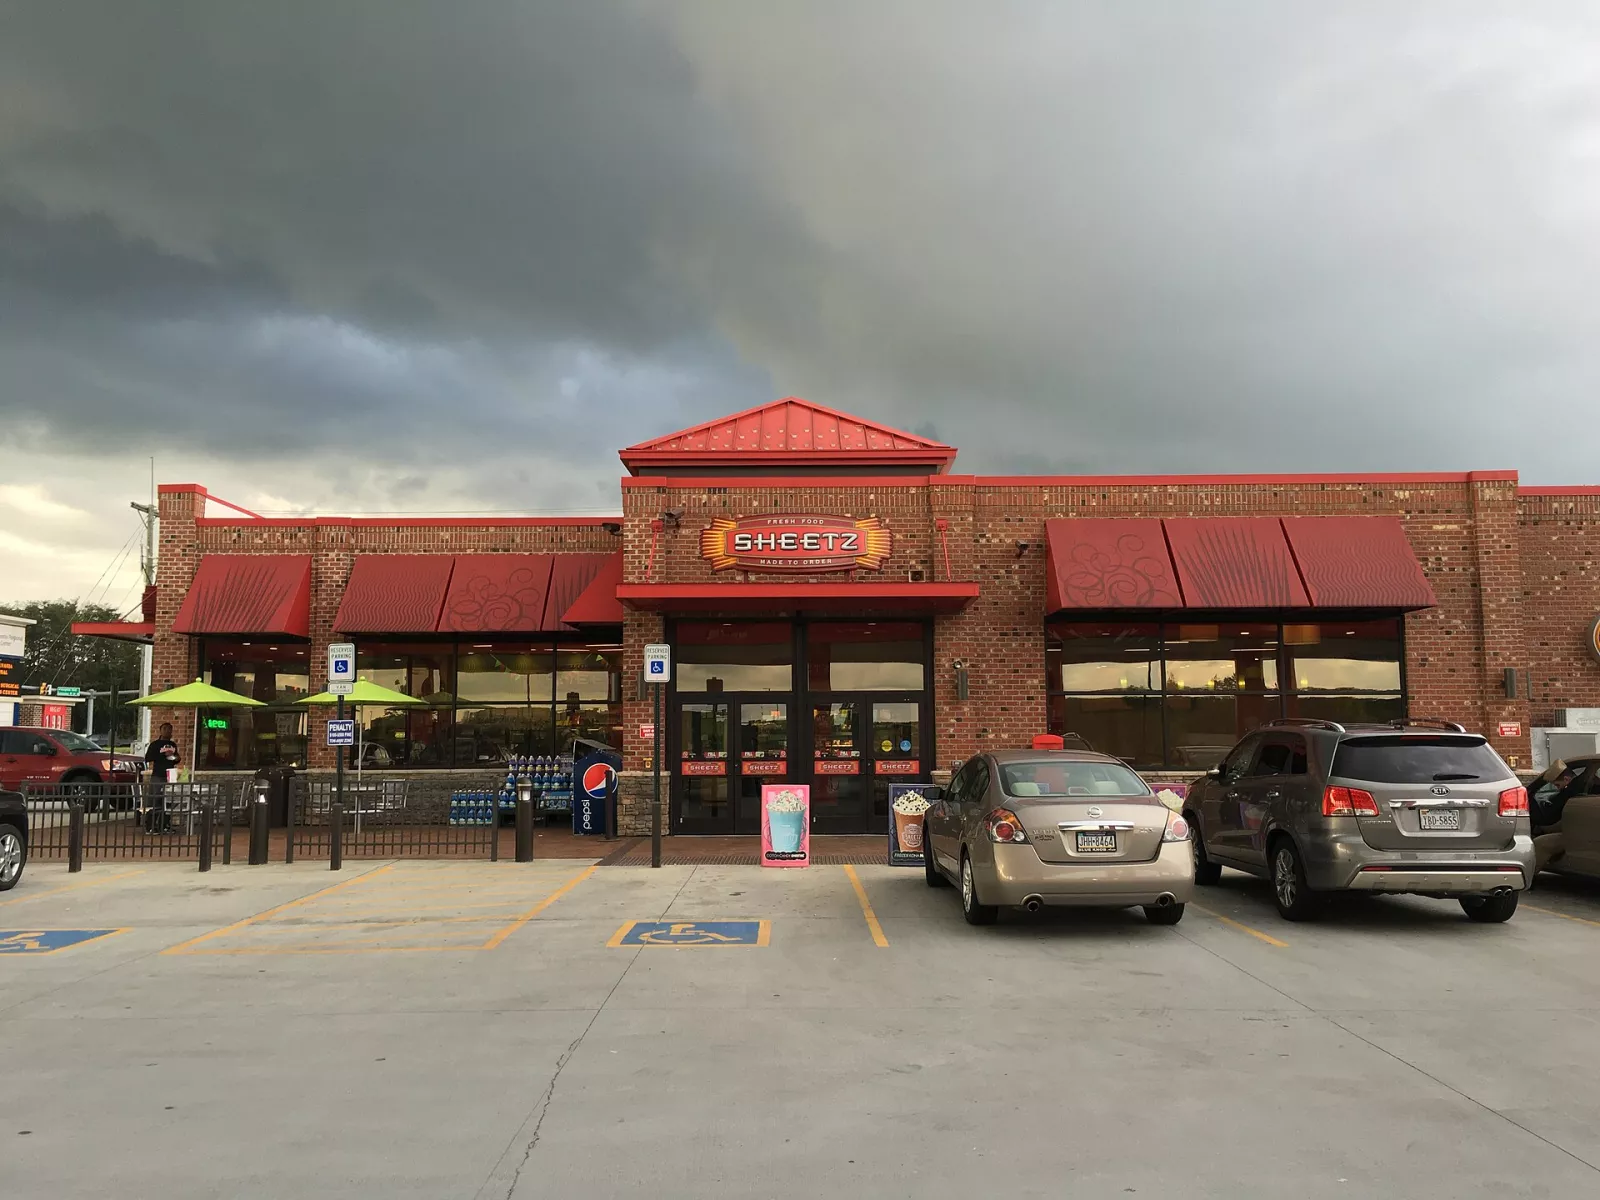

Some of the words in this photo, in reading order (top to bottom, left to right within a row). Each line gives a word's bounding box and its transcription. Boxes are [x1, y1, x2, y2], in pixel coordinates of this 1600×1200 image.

[734, 533, 859, 551] SHEETZ
[330, 723, 352, 731] PENALTY
[582, 799, 592, 830] pepsi
